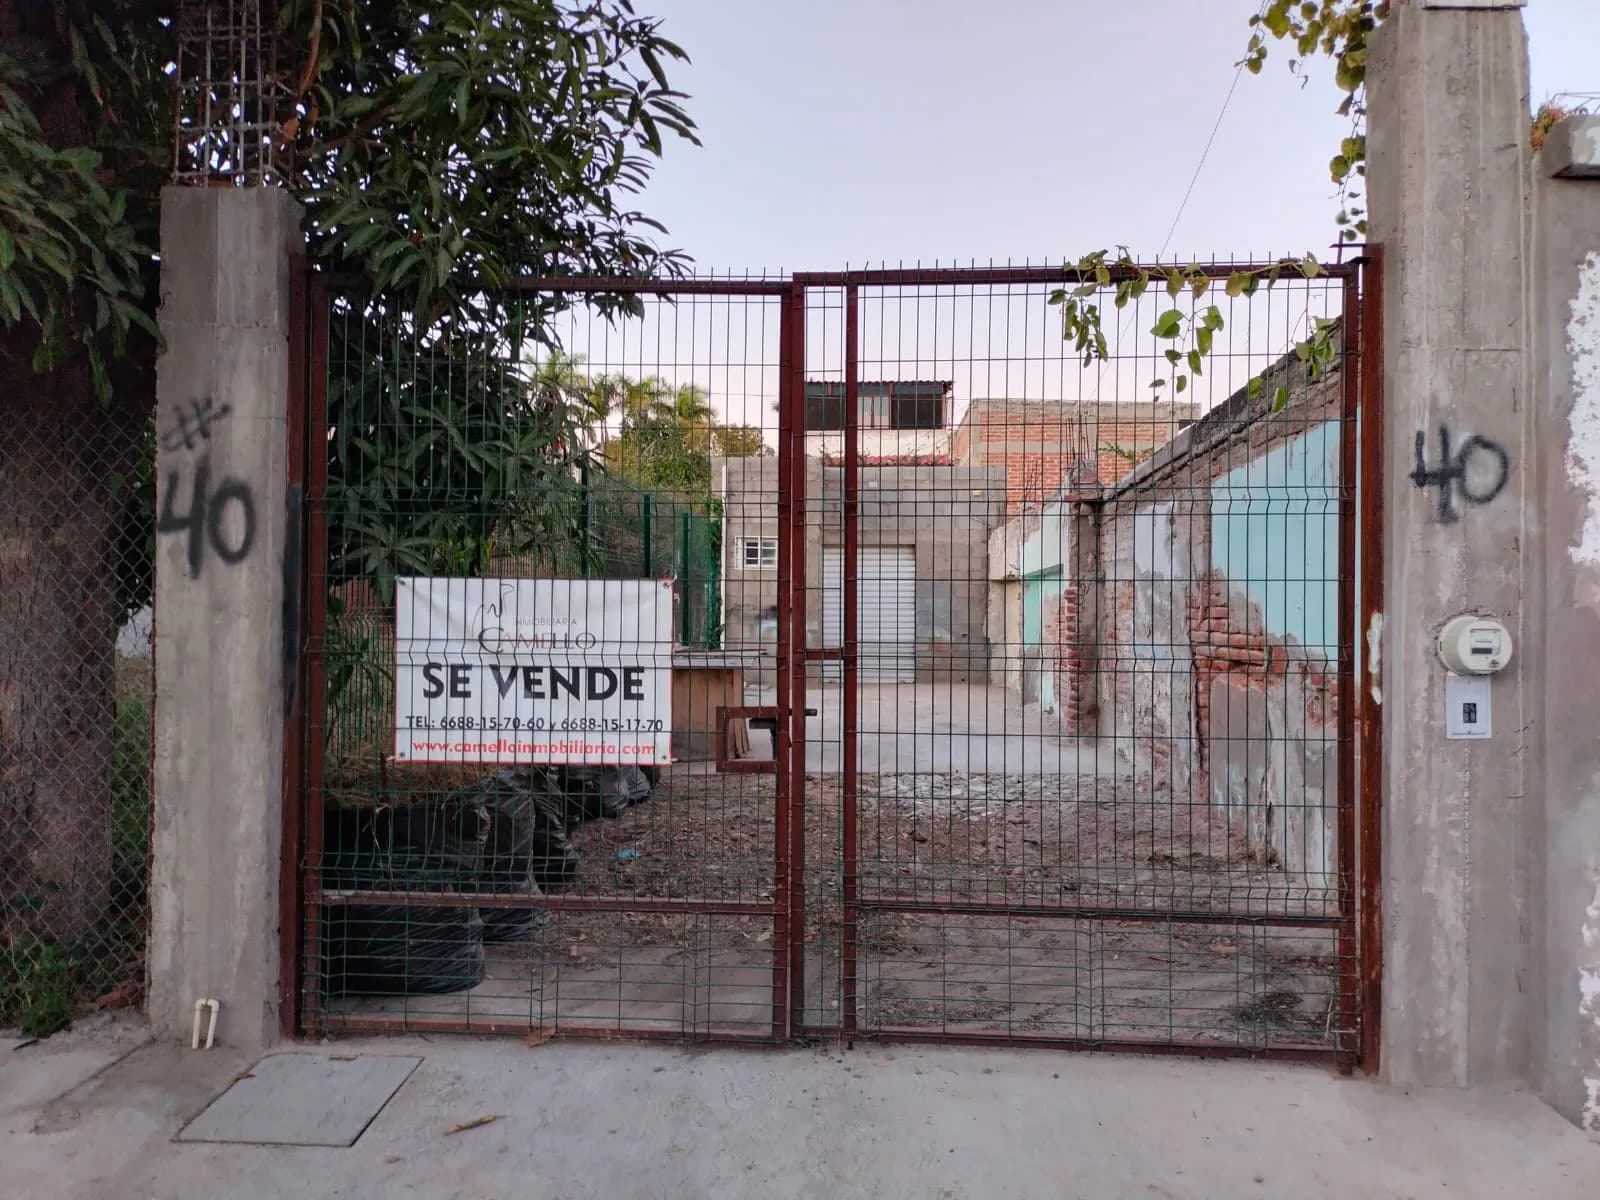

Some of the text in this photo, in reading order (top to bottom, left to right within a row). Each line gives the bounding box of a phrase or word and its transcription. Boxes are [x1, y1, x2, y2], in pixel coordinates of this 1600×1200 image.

[1408, 424, 1509, 525] 40
[157, 456, 256, 580] 40
[512, 617, 578, 626] INMOBILIARA
[478, 627, 596, 654] CAMELLO
[422, 662, 645, 701] SE VENDE
[406, 715, 435, 729] TEL:
[440, 716, 545, 731] 6688-15-70-60
[561, 717, 664, 732] 6688-15-17-70
